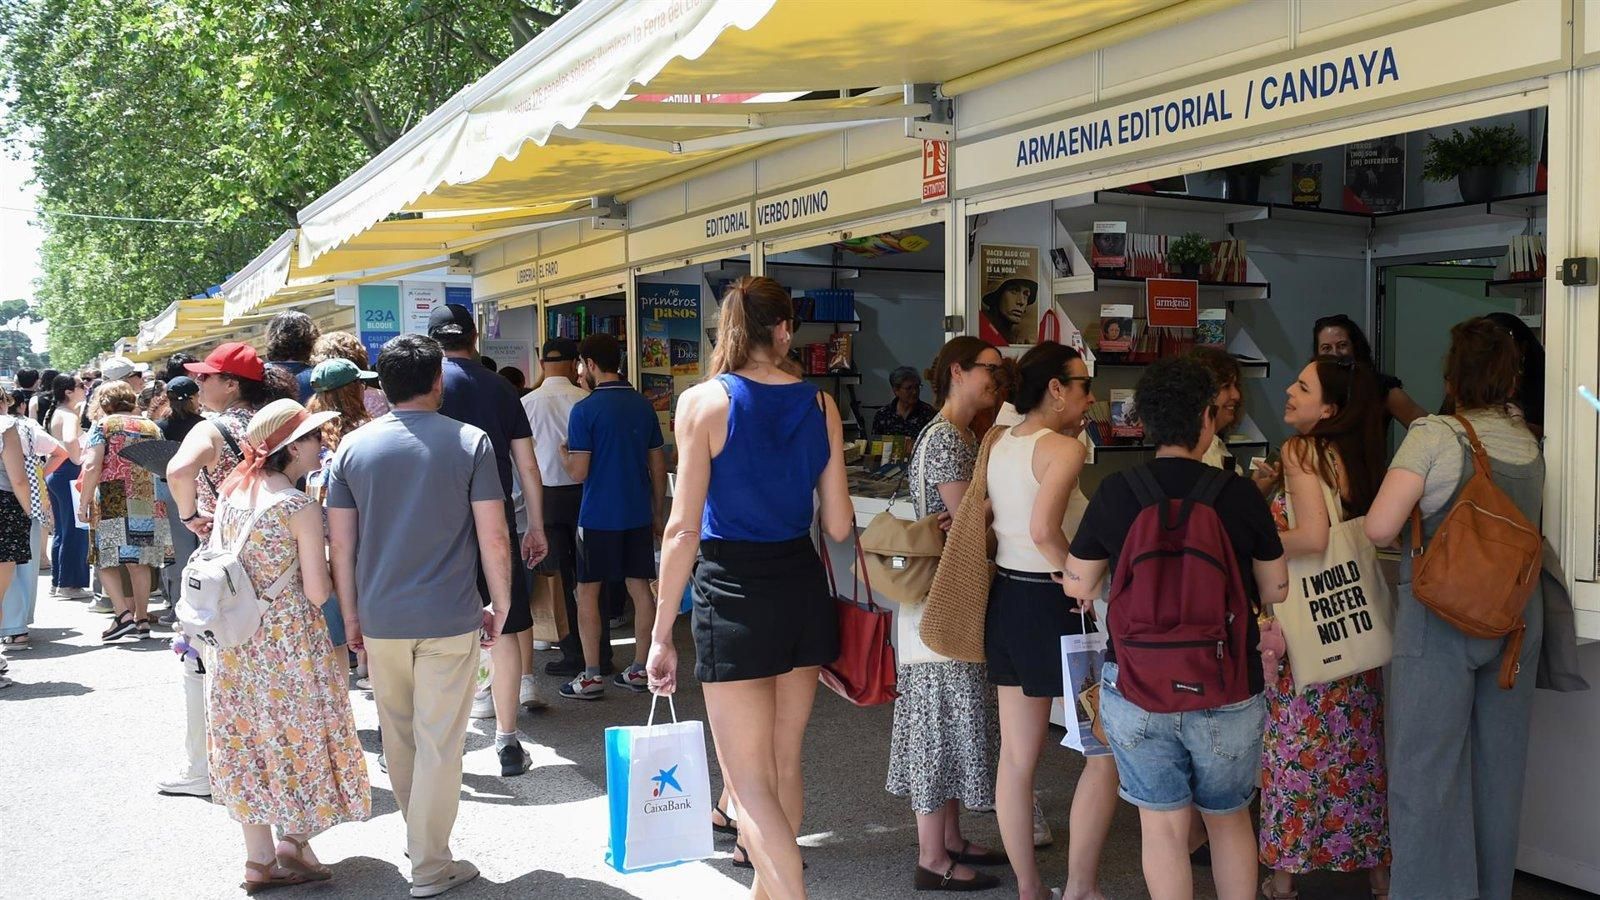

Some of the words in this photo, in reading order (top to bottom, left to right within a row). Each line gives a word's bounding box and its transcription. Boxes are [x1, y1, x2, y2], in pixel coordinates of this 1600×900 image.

[1016, 119, 1113, 168] ARMAENIA
[1118, 89, 1232, 144] EDITORIAL
[1244, 80, 1254, 119] /
[1260, 46, 1399, 111] CANDAYA
[923, 180, 945, 197] EXTINTOR
[706, 210, 749, 238] EDITORIAL
[757, 200, 790, 226] VERBO
[792, 190, 829, 219] DIVINO
[539, 264, 545, 278] EL
[545, 260, 558, 278] FARO
[986, 265, 992, 273] ES
[365, 309, 396, 321] 23A
[652, 307, 697, 322] pasos
[1302, 577, 1310, 598] I
[1310, 560, 1361, 595] WOULD
[1309, 586, 1368, 621] PREFER
[1317, 616, 1349, 645] NOT
[1349, 610, 1373, 634] TO
[644, 799, 692, 815] CaixaBank
